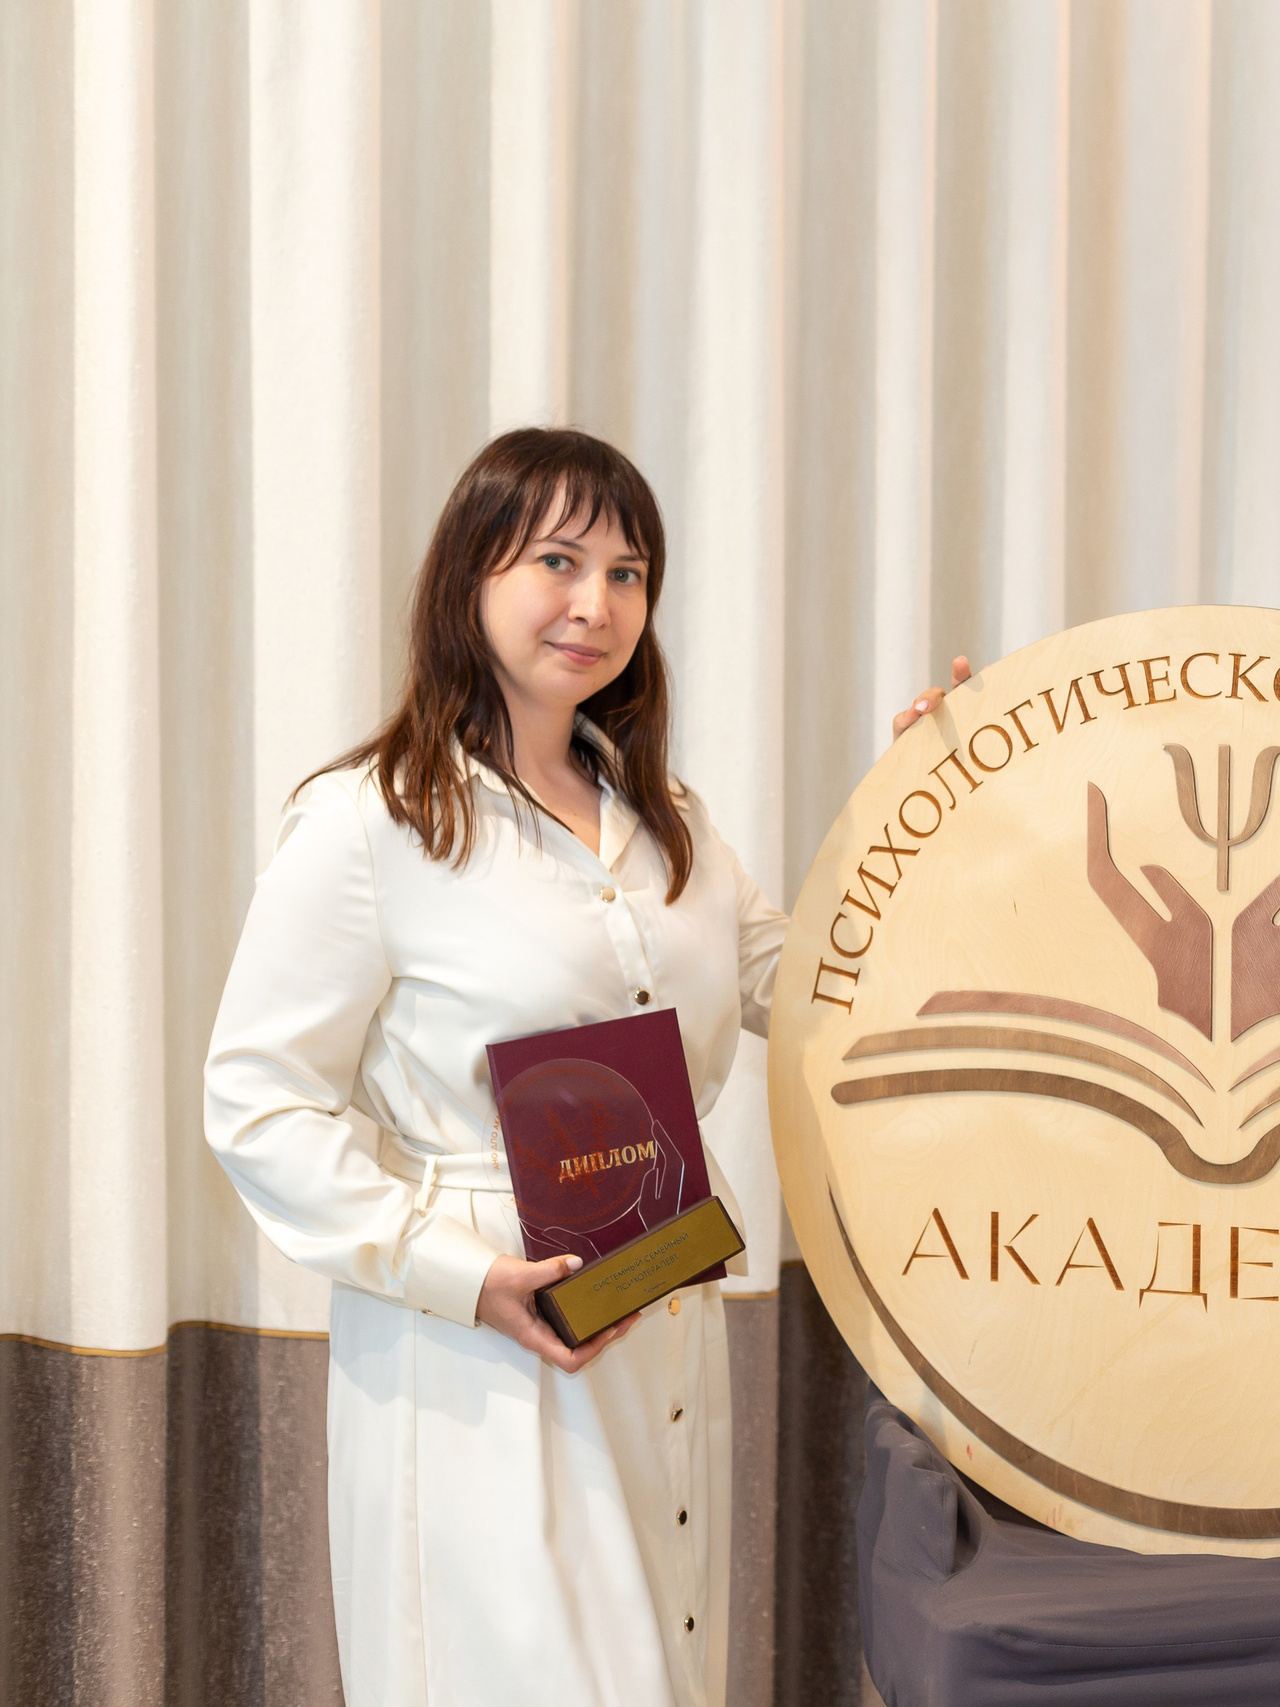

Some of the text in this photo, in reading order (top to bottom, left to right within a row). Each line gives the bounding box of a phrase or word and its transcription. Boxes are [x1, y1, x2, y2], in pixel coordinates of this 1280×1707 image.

[558, 1140, 656, 1184] ДИПЛОМ
[593, 1232, 689, 1292] СИСТЕМНЫЙ СЕМЕЙНЫЙ
[616, 1254, 678, 1293] ПСИХОТЕРАПЕВТ
